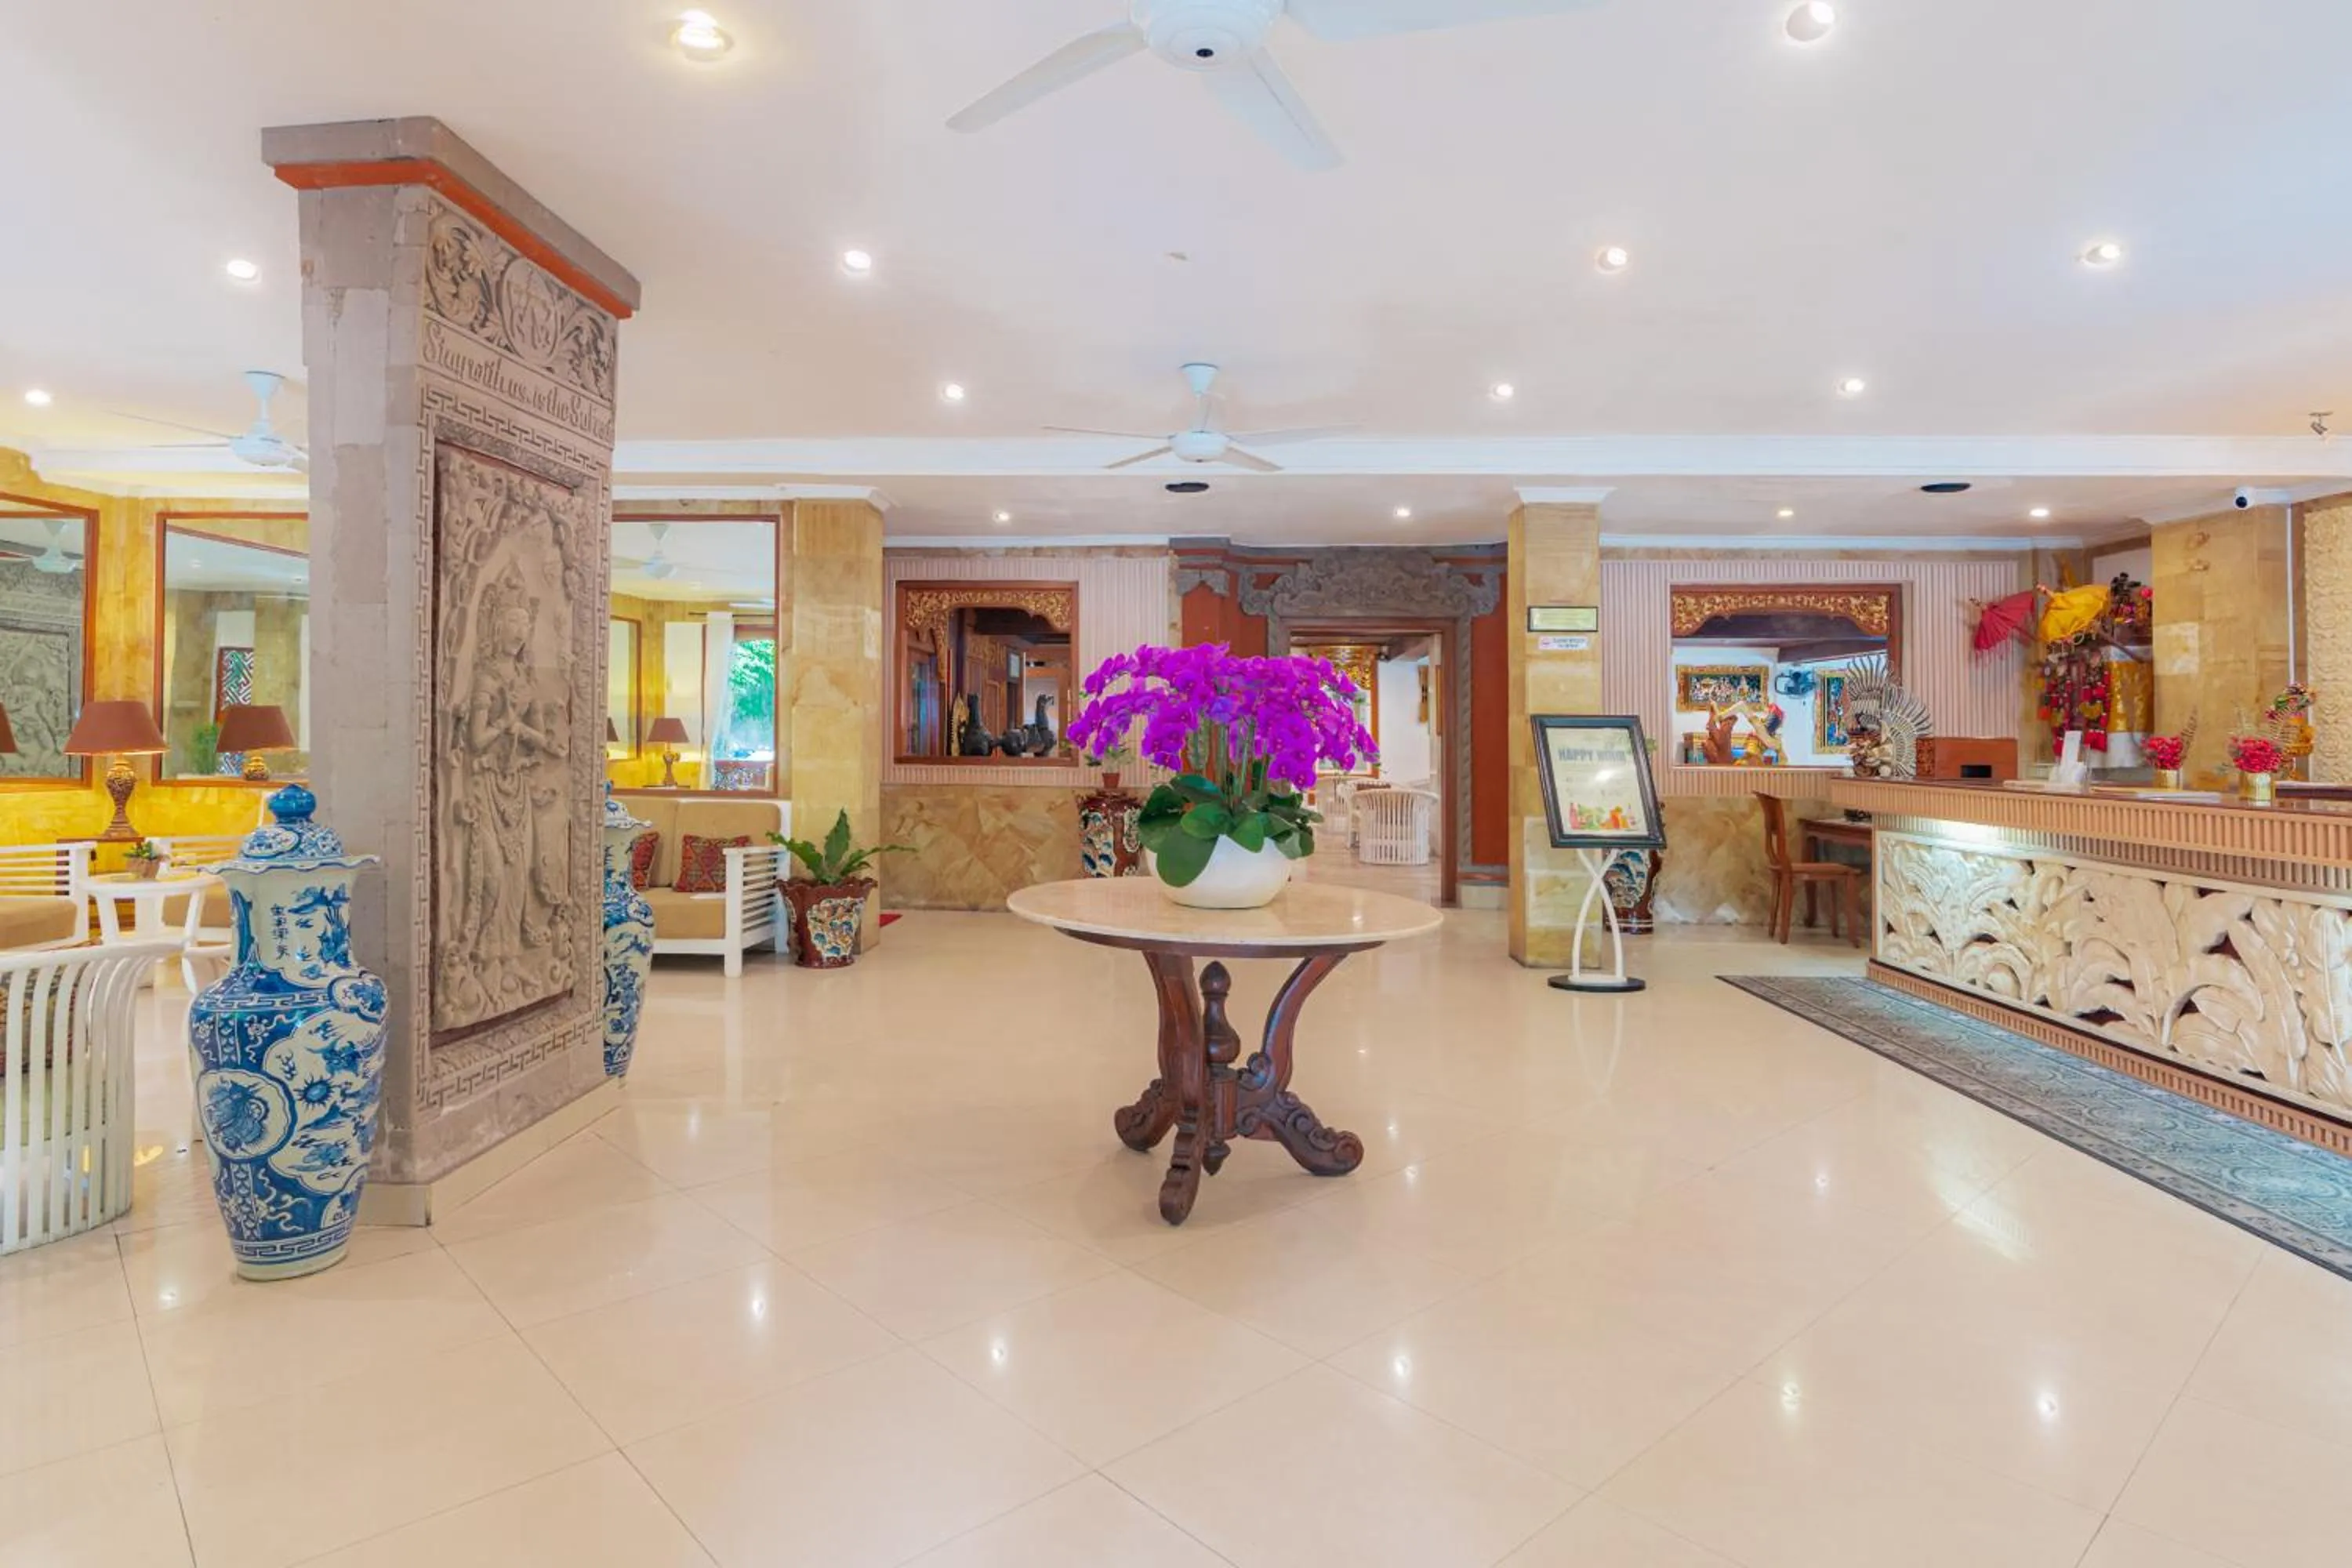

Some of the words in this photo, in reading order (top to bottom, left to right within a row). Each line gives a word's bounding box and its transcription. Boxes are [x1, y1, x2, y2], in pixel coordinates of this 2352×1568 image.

[423, 321, 466, 380] Stay
[468, 358, 504, 393] with
[546, 387, 569, 422] the
[1558, 749, 1593, 761] HAPPY
